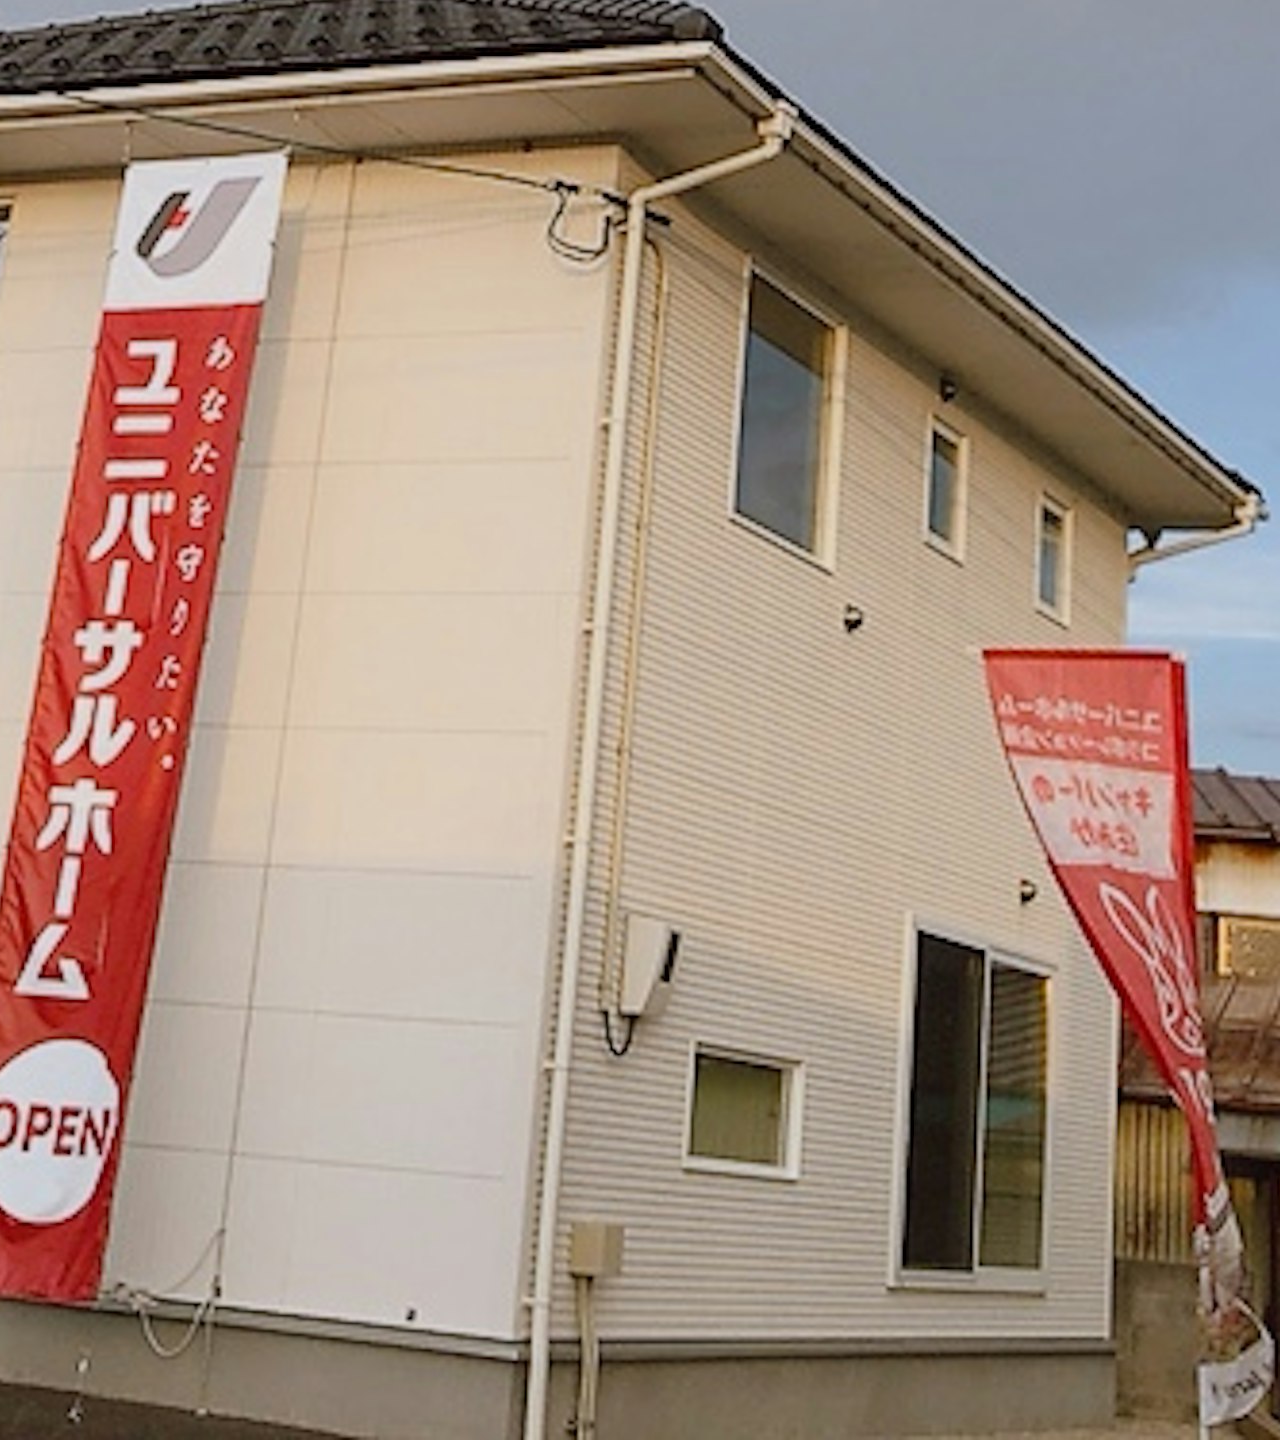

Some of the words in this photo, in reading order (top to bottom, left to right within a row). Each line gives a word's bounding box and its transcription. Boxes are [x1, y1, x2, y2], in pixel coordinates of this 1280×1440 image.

[13, 339, 181, 1000] ユニバーサルホーム
